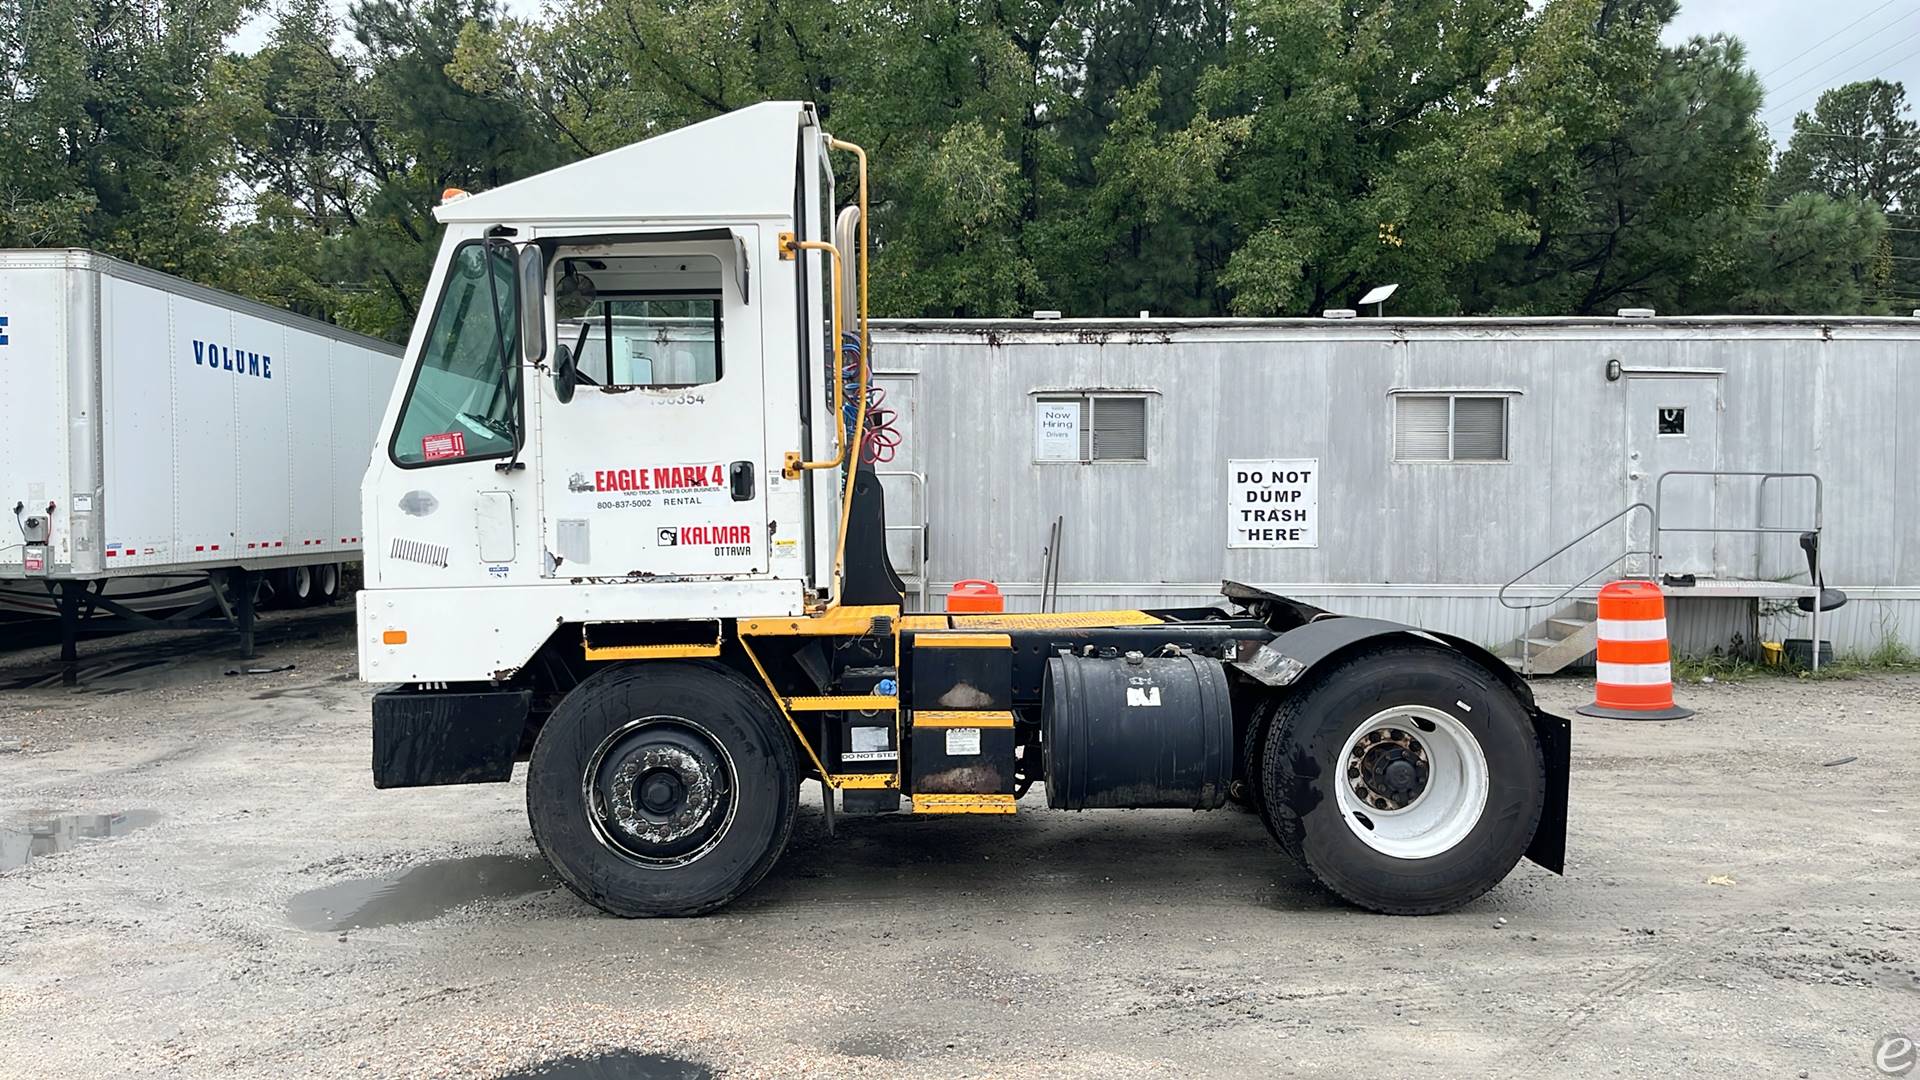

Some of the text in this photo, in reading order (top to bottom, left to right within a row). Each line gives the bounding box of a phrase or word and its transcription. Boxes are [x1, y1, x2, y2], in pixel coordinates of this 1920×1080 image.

[192, 340, 272, 379] VOLUME
[1045, 411, 1071, 419] Now
[1043, 420, 1073, 430] Hiring
[595, 465, 724, 492] EAGLE MARK 4
[1237, 471, 1311, 484] DO NOT
[1246, 490, 1301, 503] DUMP
[596, 497, 702, 510] 800-837-5002 RENTAL
[1240, 509, 1306, 522] TRASH
[681, 525, 751, 545] KALMAR
[1248, 528, 1300, 541] HERE
[714, 546, 751, 557] OTTAWA
